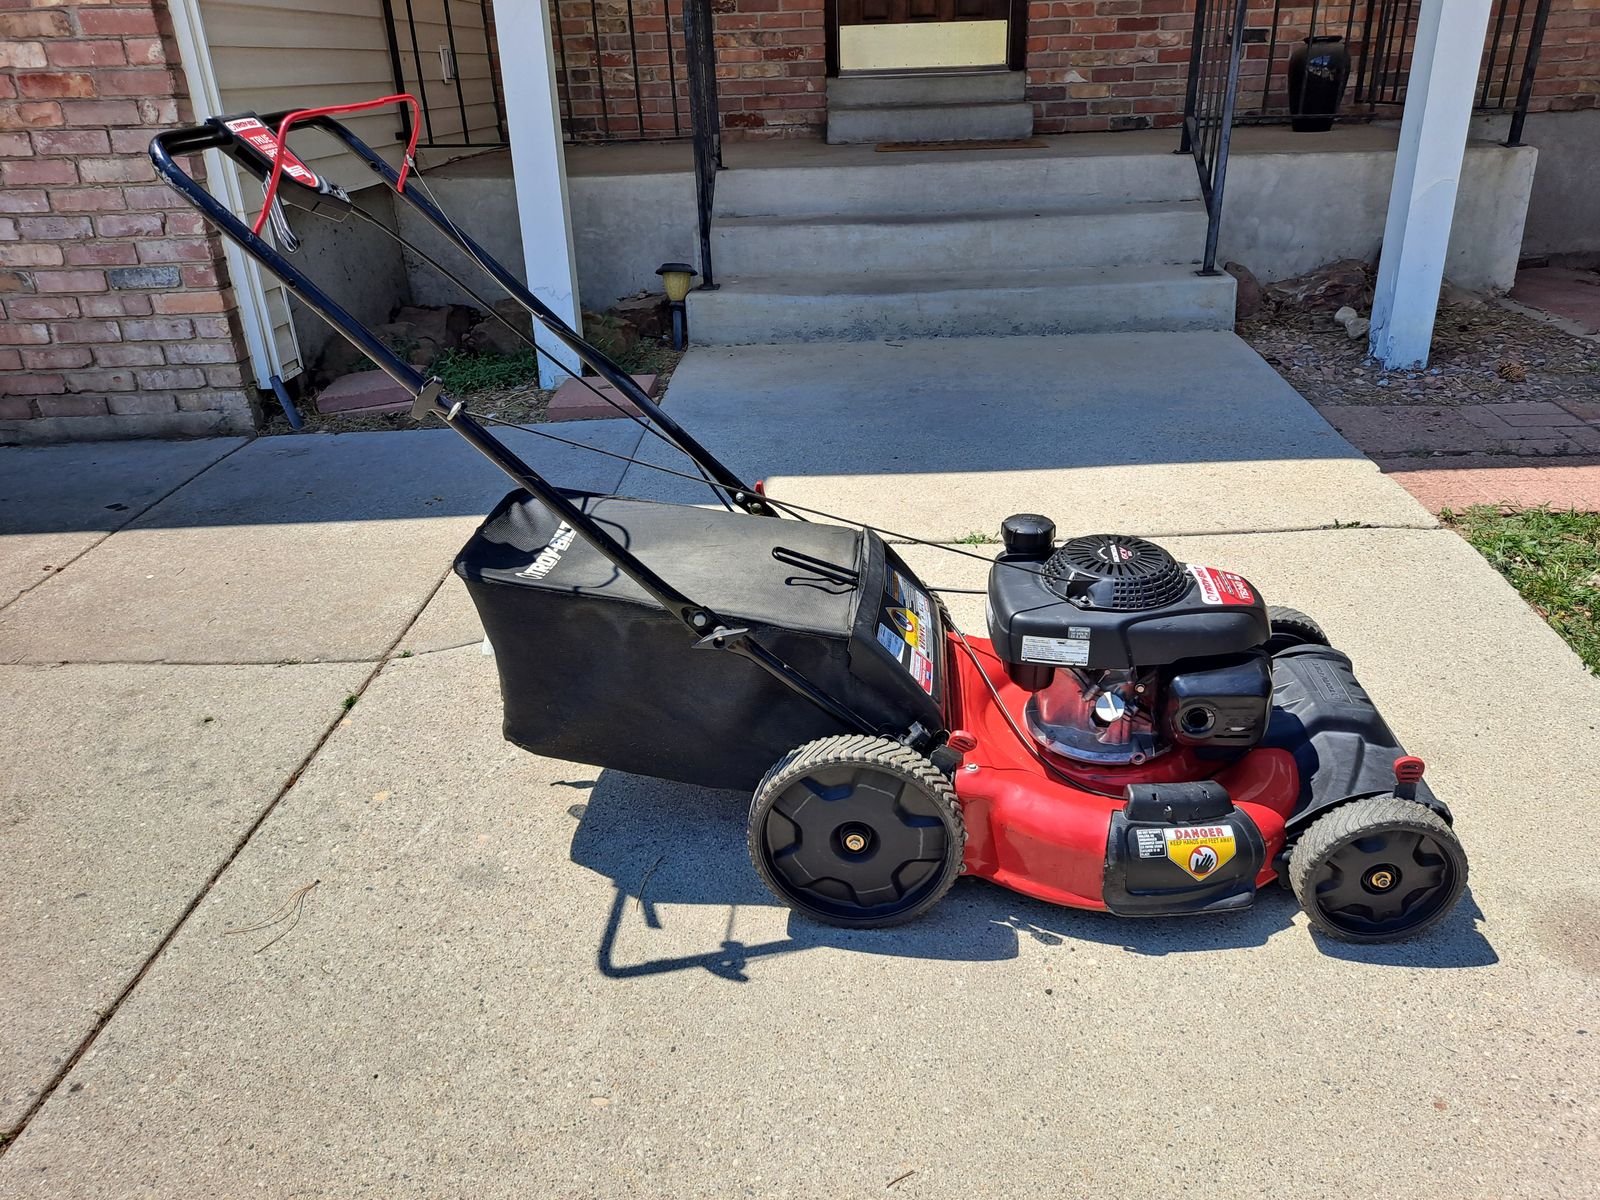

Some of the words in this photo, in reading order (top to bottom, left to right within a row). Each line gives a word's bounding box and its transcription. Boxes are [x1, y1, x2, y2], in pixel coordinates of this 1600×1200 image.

[233, 119, 259, 130] TROY-BILT
[250, 134, 273, 145] TRUE
[1174, 827, 1224, 840] DANGER
[1183, 838, 1200, 846] HANDS
